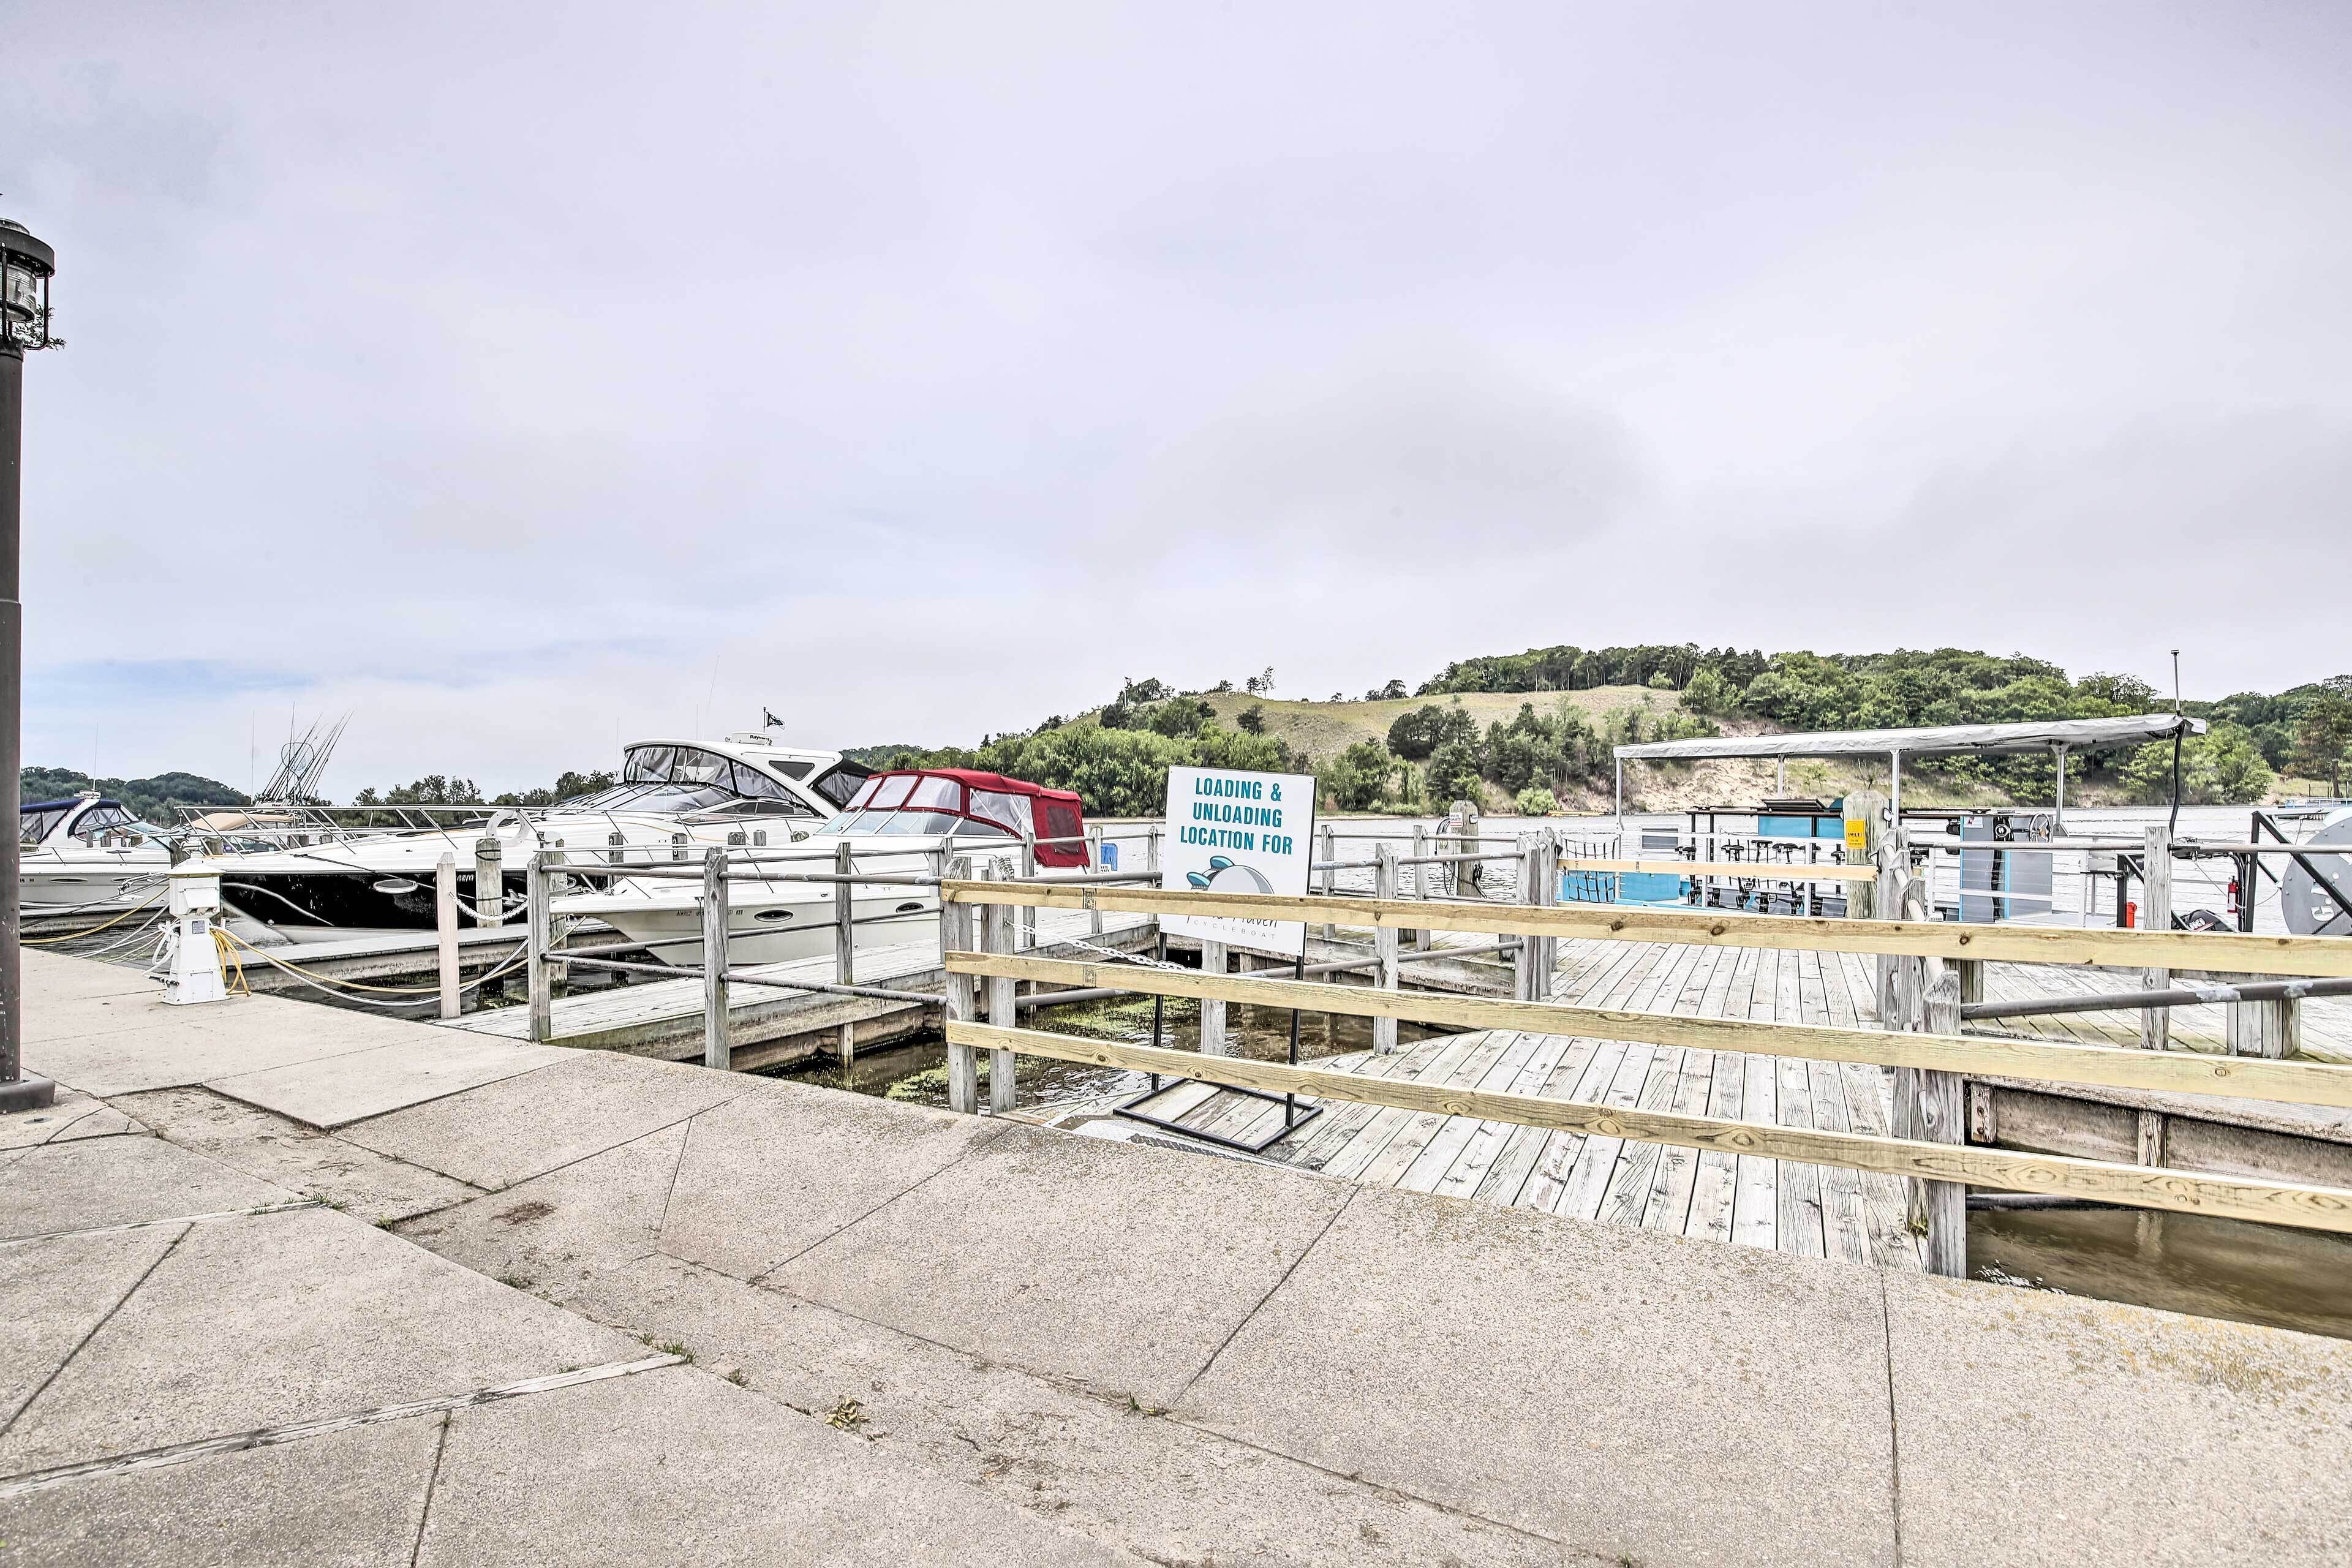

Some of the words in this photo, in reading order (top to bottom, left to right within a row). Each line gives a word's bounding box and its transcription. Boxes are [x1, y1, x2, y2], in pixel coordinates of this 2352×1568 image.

[1196, 777, 1262, 800] LOADING
[1270, 783, 1282, 802] &
[1193, 802, 1282, 827] UNLOADING
[1180, 826, 1254, 851] LOCATION
[1262, 834, 1292, 855] FOR
[1194, 919, 1276, 940] CYCLEBOAT
